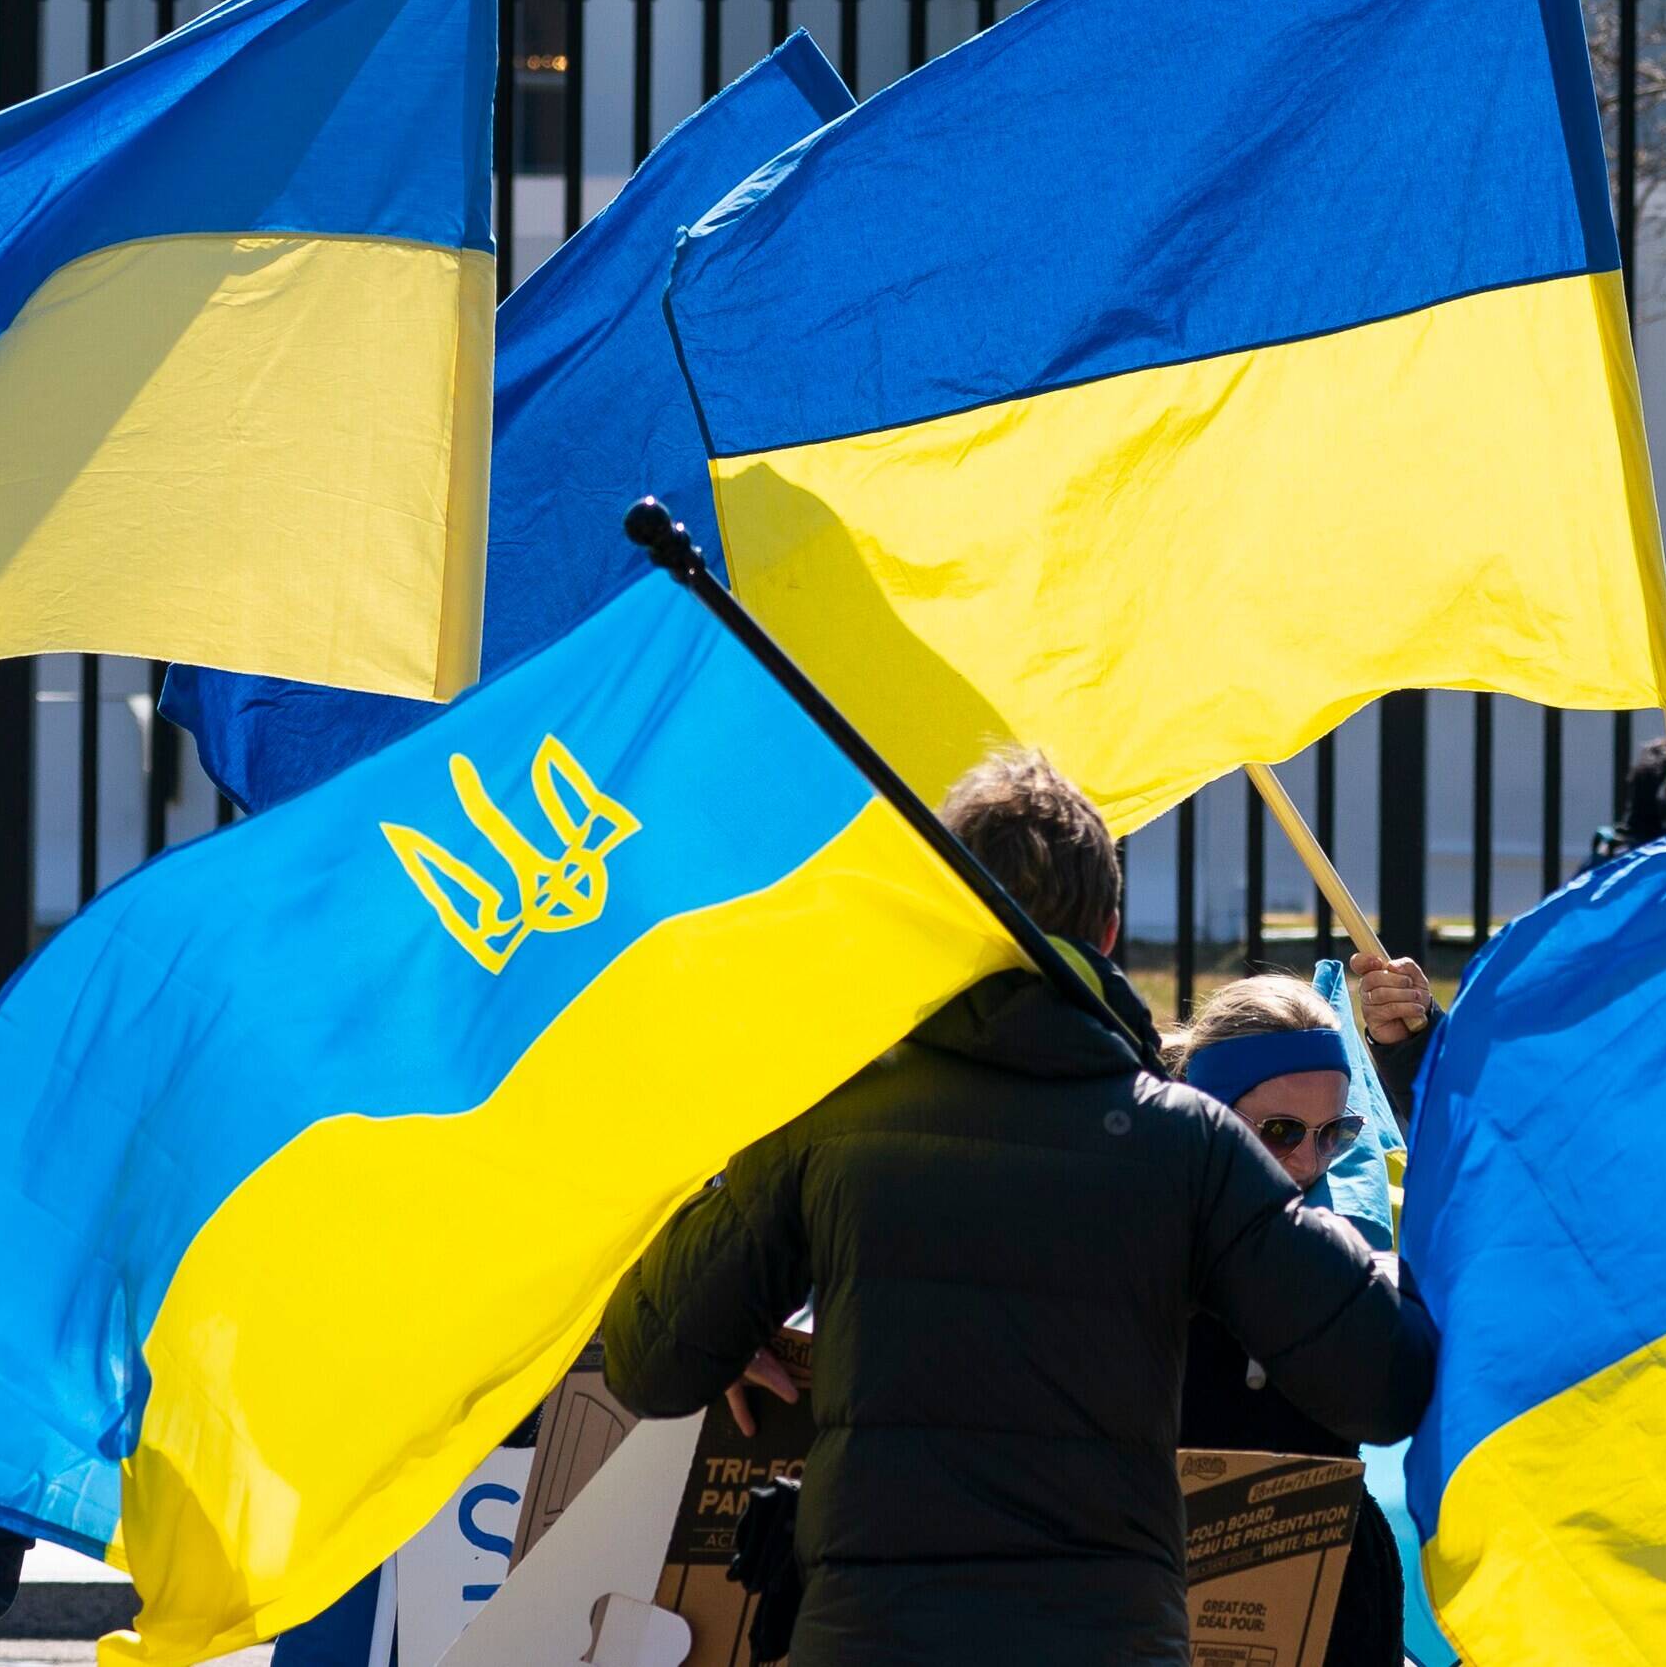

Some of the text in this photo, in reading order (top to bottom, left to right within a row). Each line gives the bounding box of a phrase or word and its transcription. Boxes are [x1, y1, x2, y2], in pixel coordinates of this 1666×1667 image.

[1227, 1505, 1276, 1531] BOARD
[1222, 1531, 1243, 1550] DE
[1202, 1598, 1267, 1616] GREAT FOR:
[1229, 1617, 1265, 1632] POUR:
